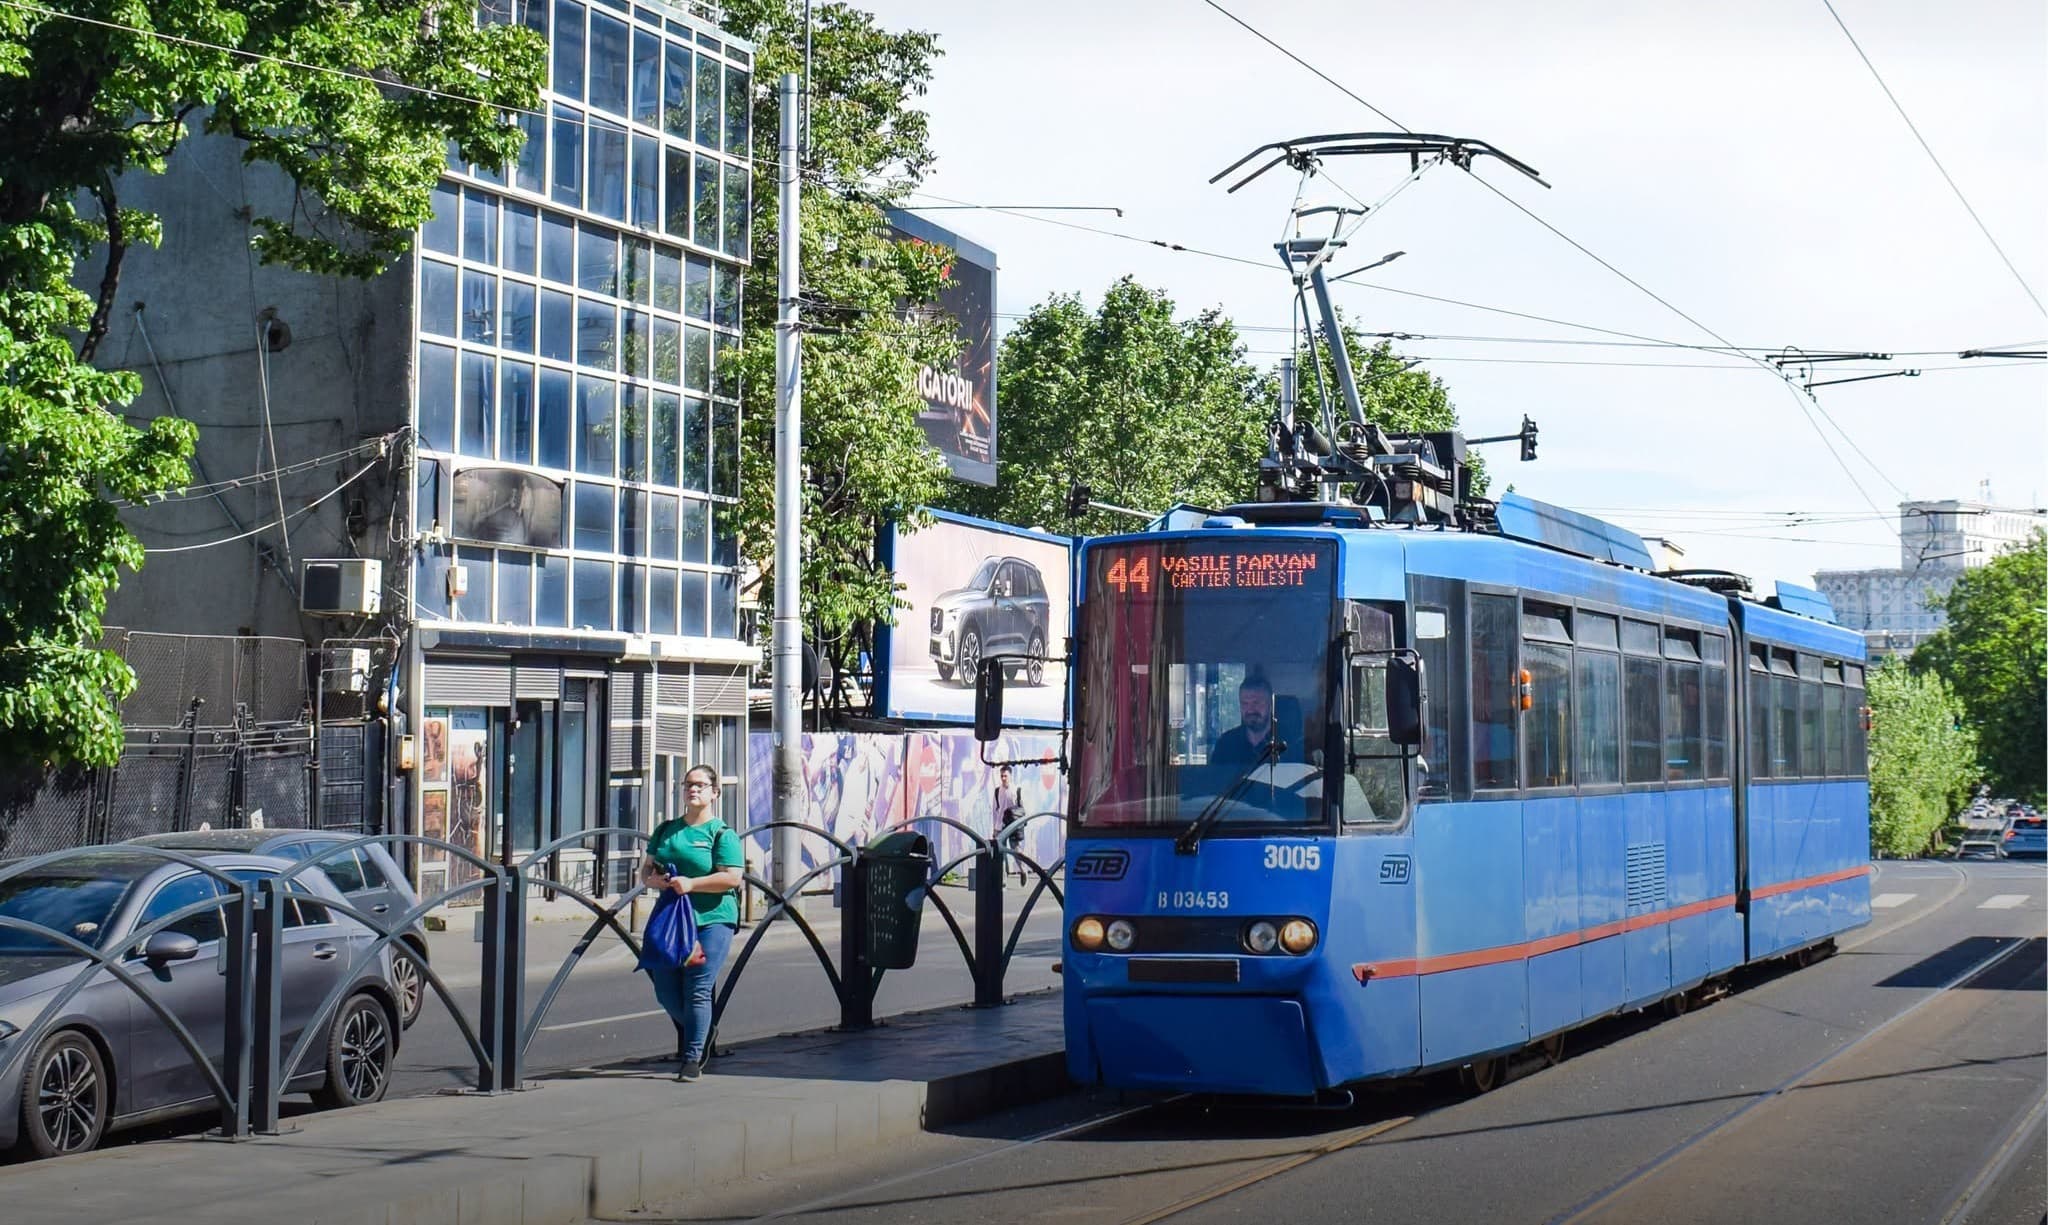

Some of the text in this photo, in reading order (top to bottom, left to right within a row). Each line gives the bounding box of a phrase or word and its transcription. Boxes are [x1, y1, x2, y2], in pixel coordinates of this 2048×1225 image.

[1161, 553, 1316, 572] VASILE PARVAN
[1106, 557, 1150, 593] 44
[1171, 570, 1304, 588] CARTIER GIULESTI
[1072, 853, 1126, 876] STB
[1263, 844, 1321, 871] 3005
[1379, 859, 1409, 879] STB
[1158, 891, 1229, 909] B 03453
